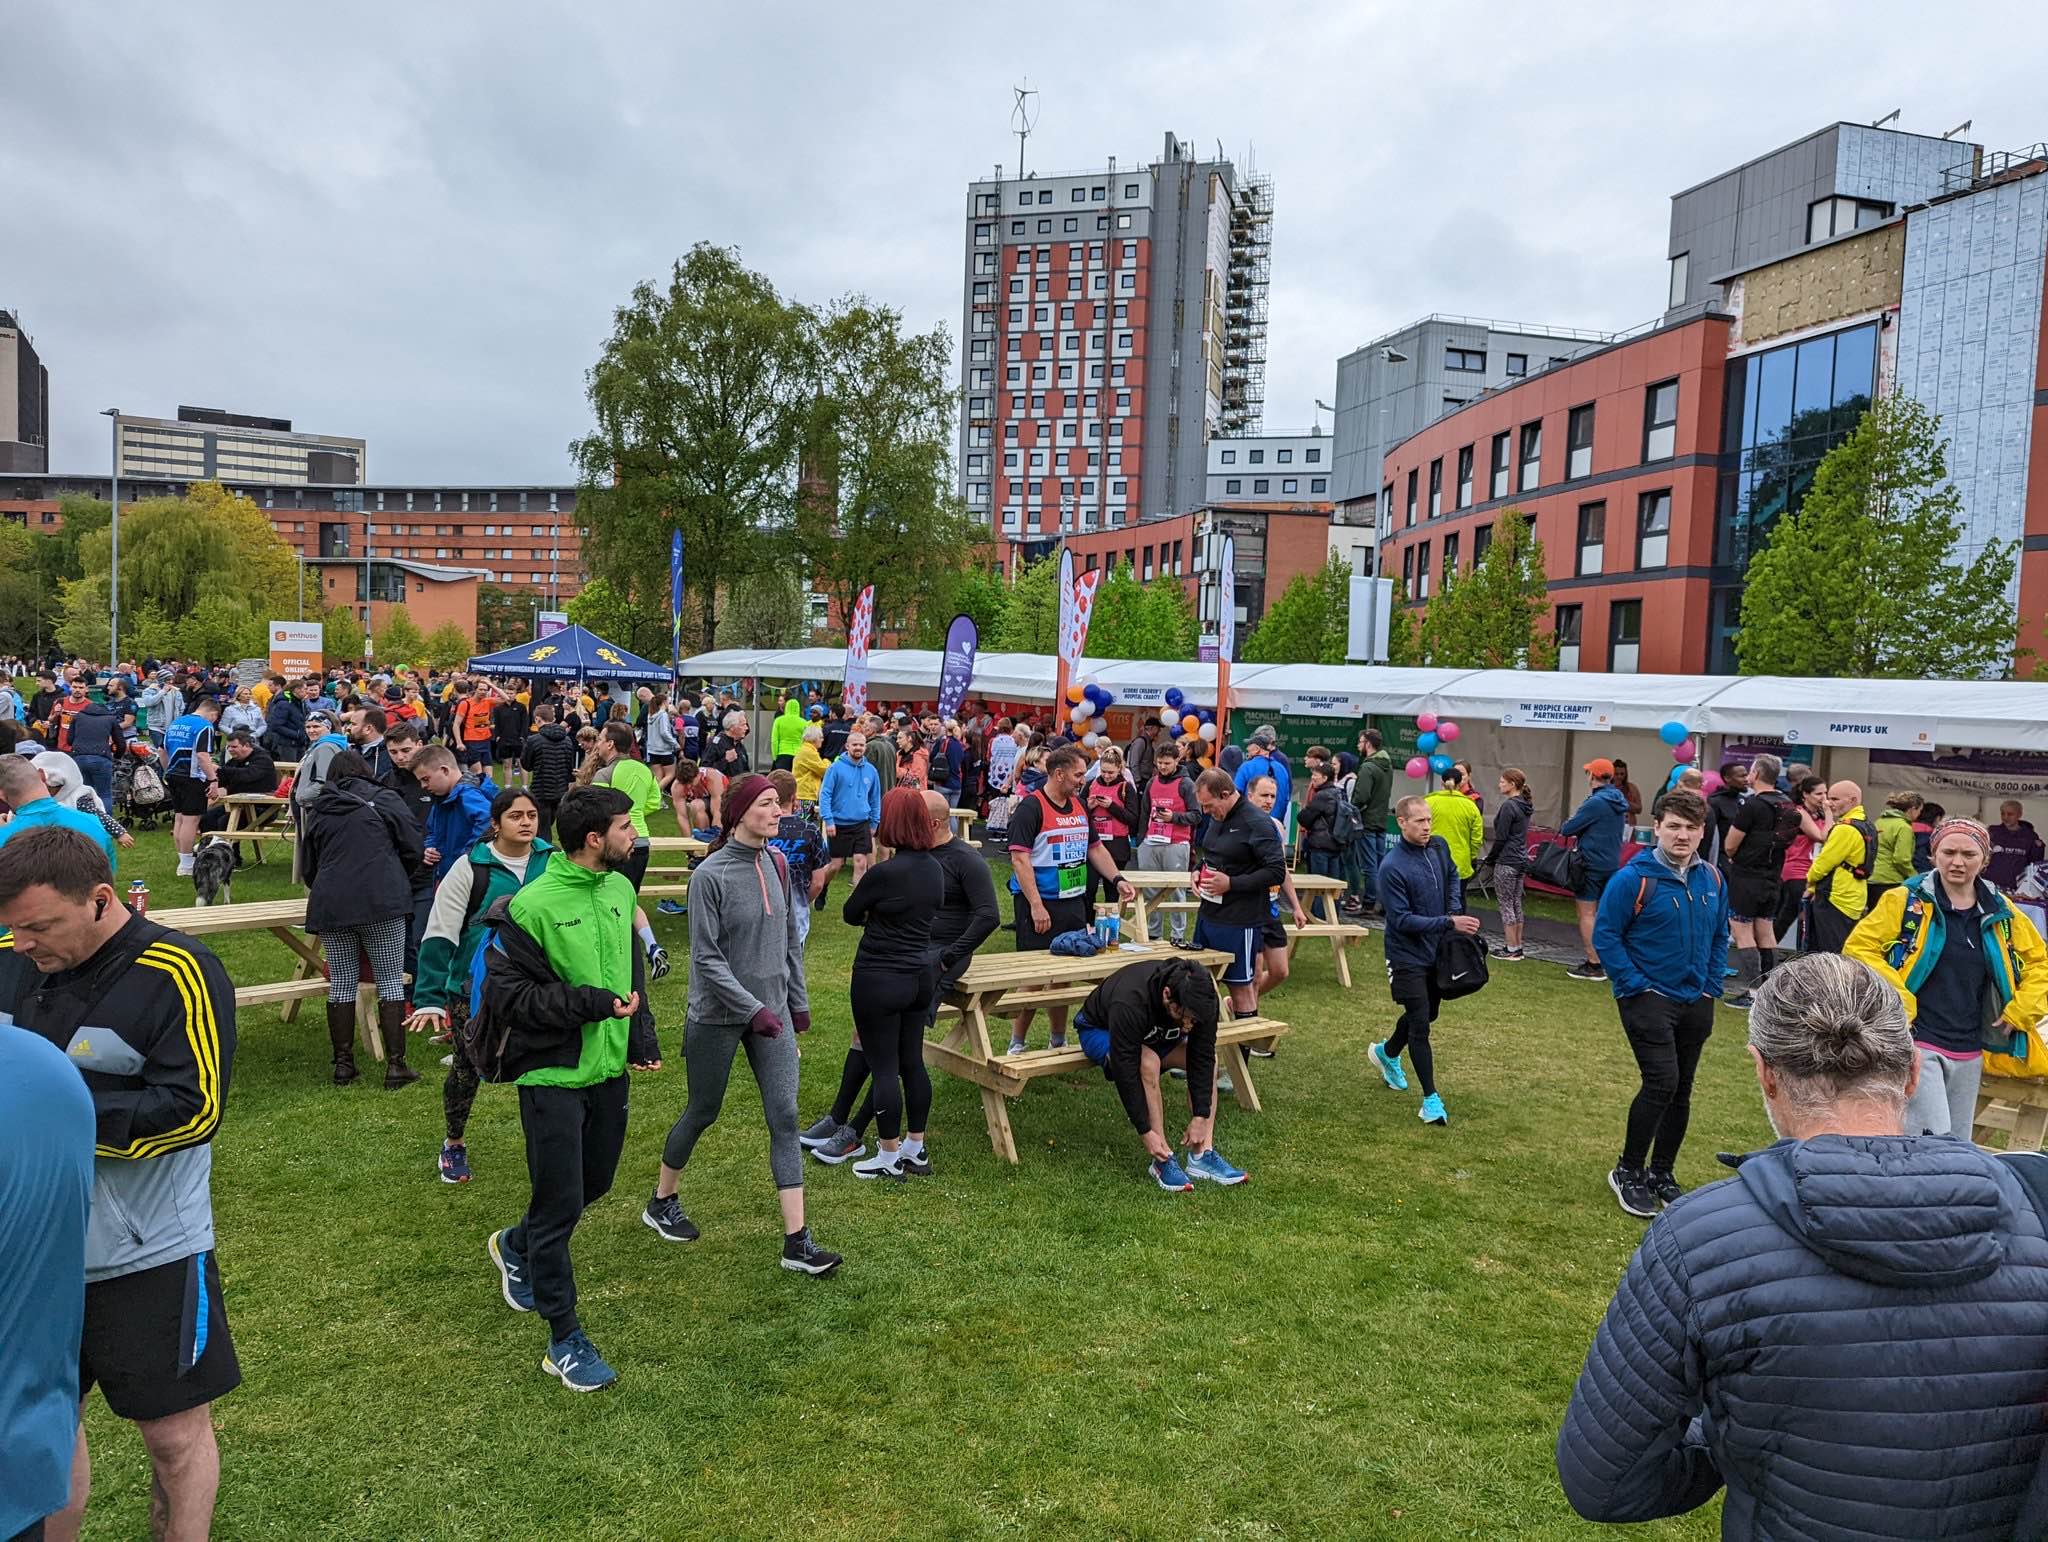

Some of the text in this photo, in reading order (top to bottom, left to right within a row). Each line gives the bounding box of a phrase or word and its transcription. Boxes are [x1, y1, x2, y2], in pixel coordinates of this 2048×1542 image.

[288, 632, 318, 640] enthuse
[471, 664, 497, 672] UNIVERSITY
[504, 665, 534, 673] BIRMINGHAM
[556, 668, 577, 676] FITNESS
[617, 670, 642, 678] BIRMINGHAM
[1297, 695, 1349, 704] MACMILLAN CANCER
[1520, 703, 1593, 713] THE HOSPICE CHARITY
[1533, 712, 1579, 720] PARTNERSHIP
[1830, 723, 1889, 734] PAPYRUS UK
[1994, 781, 2018, 791] 0800
[2021, 783, 2040, 791] 068
[1055, 815, 1082, 826] SIMON
[557, 1353, 579, 1375] N
